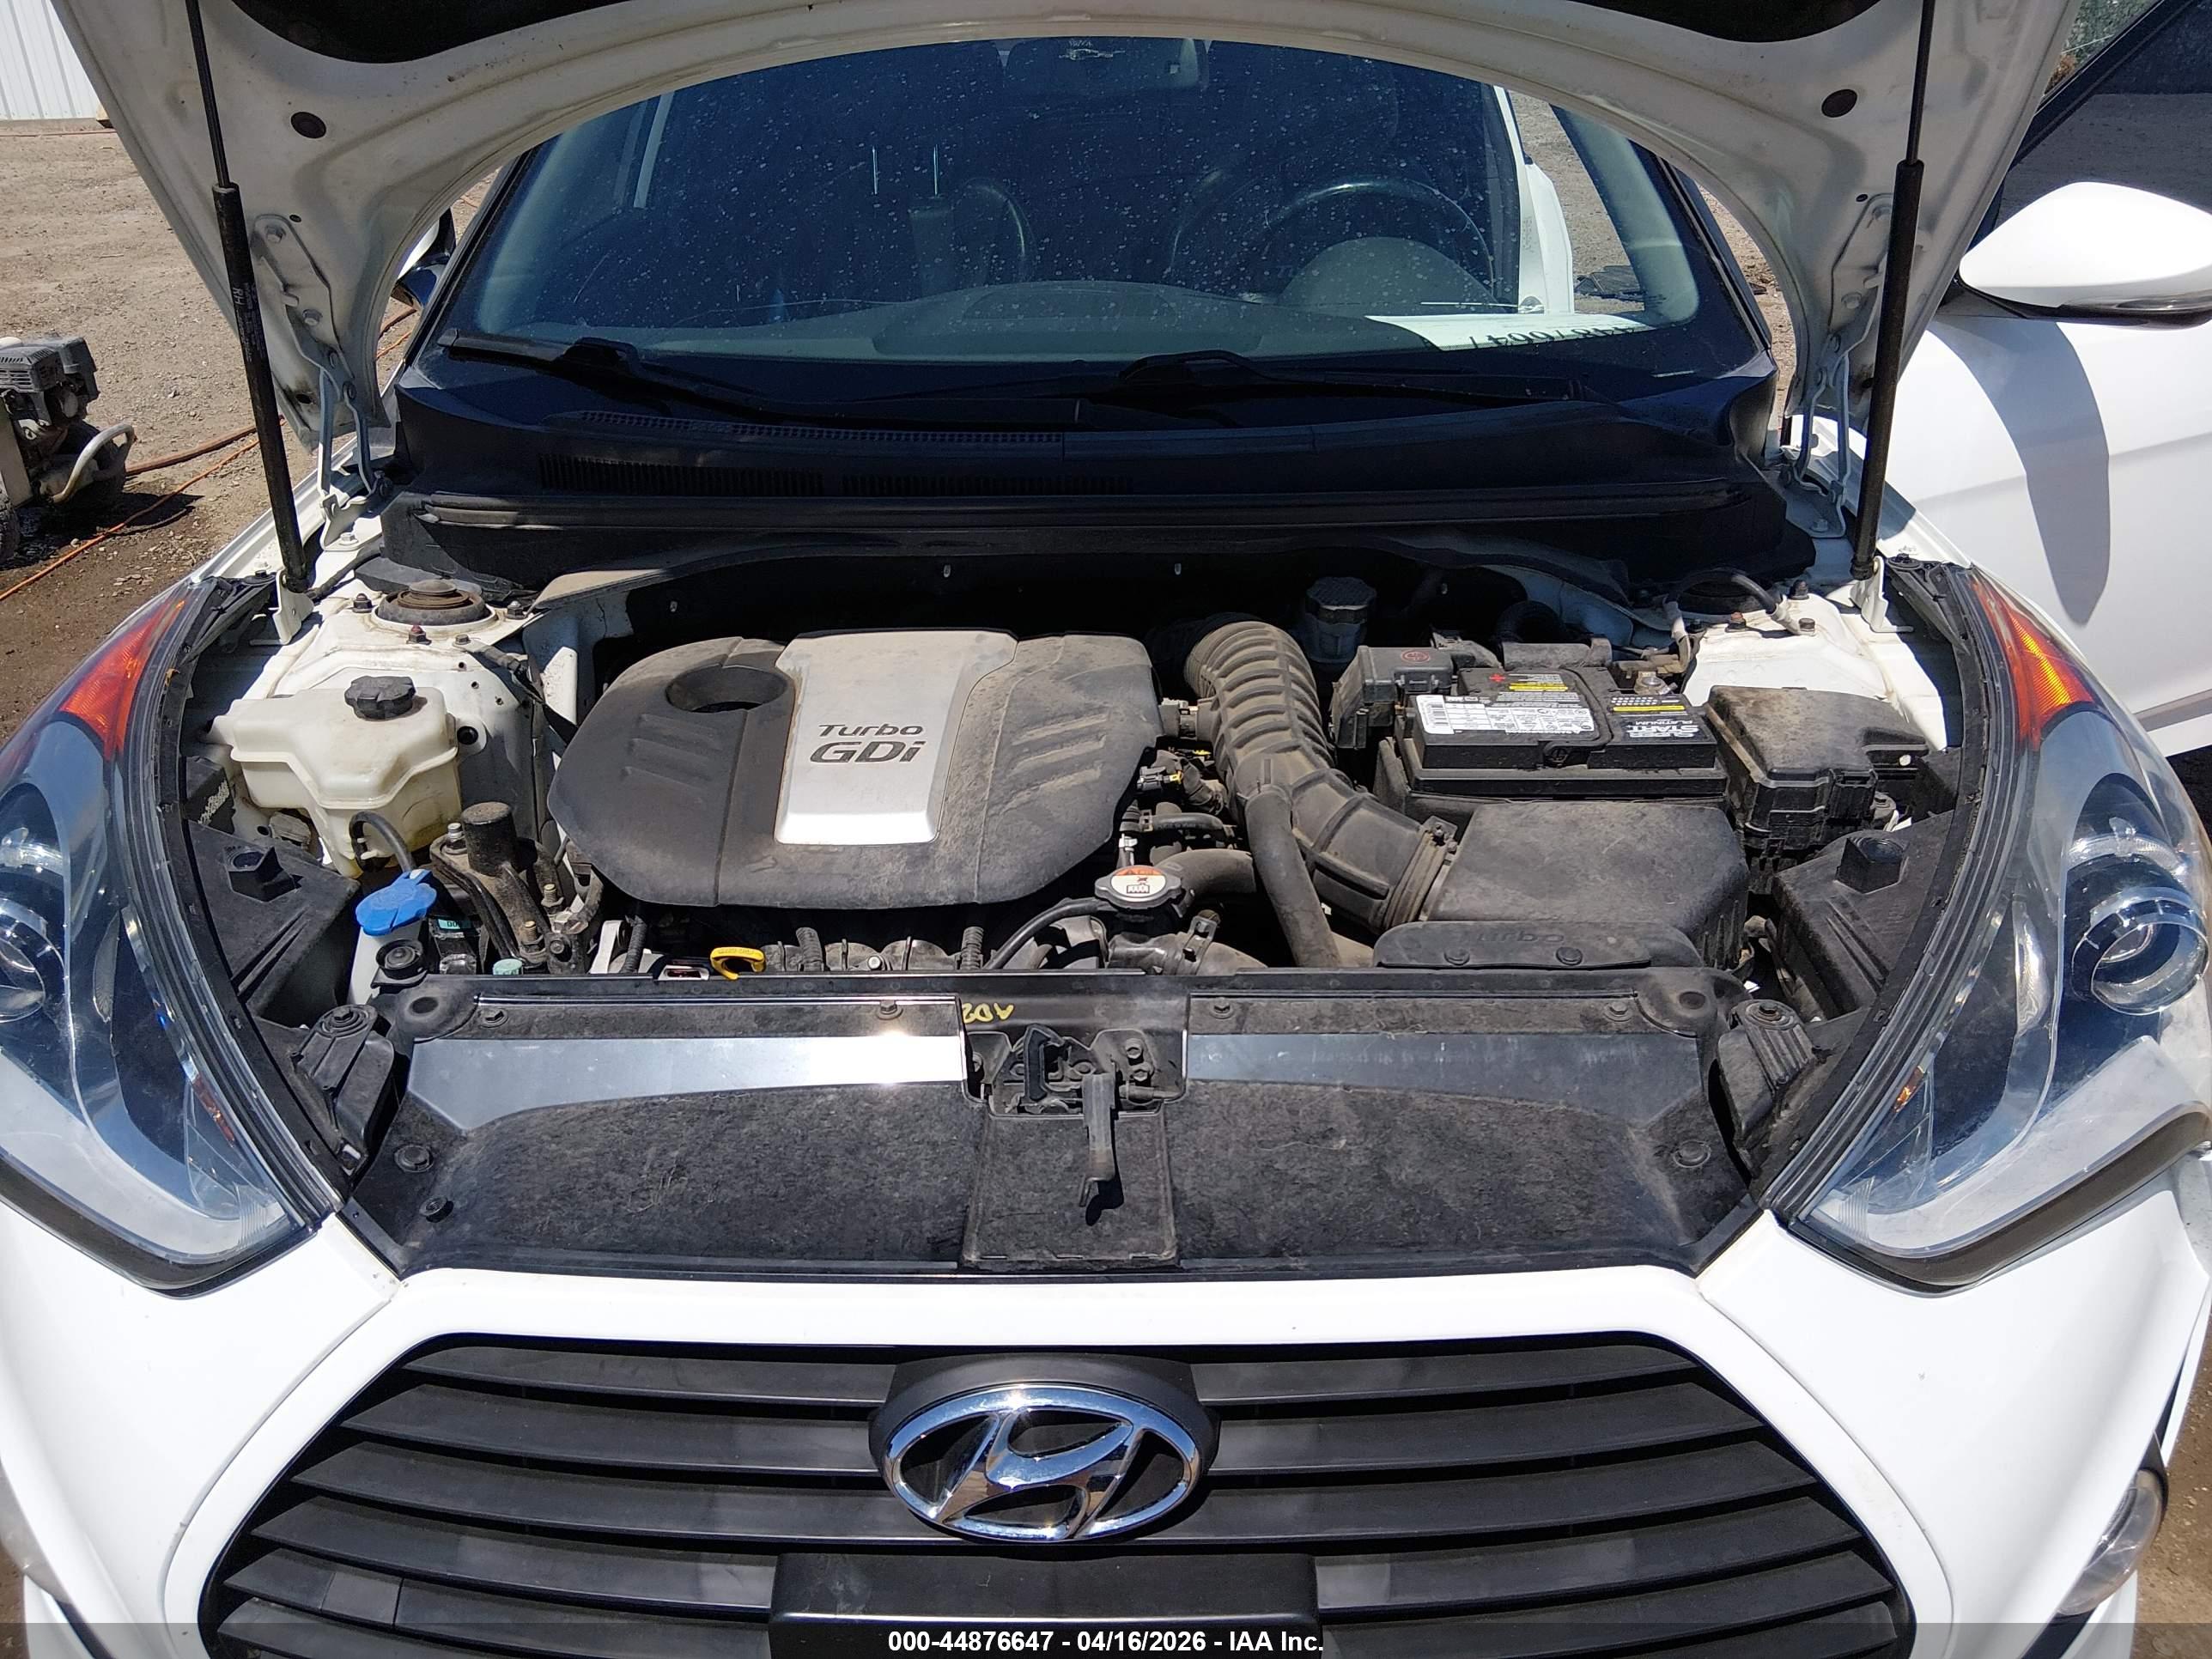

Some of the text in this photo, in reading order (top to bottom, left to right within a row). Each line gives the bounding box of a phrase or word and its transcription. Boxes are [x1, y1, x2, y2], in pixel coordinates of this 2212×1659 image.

[818, 723, 924, 737] Turbo
[1626, 724, 1699, 732] START
[810, 740, 927, 763] GDi
